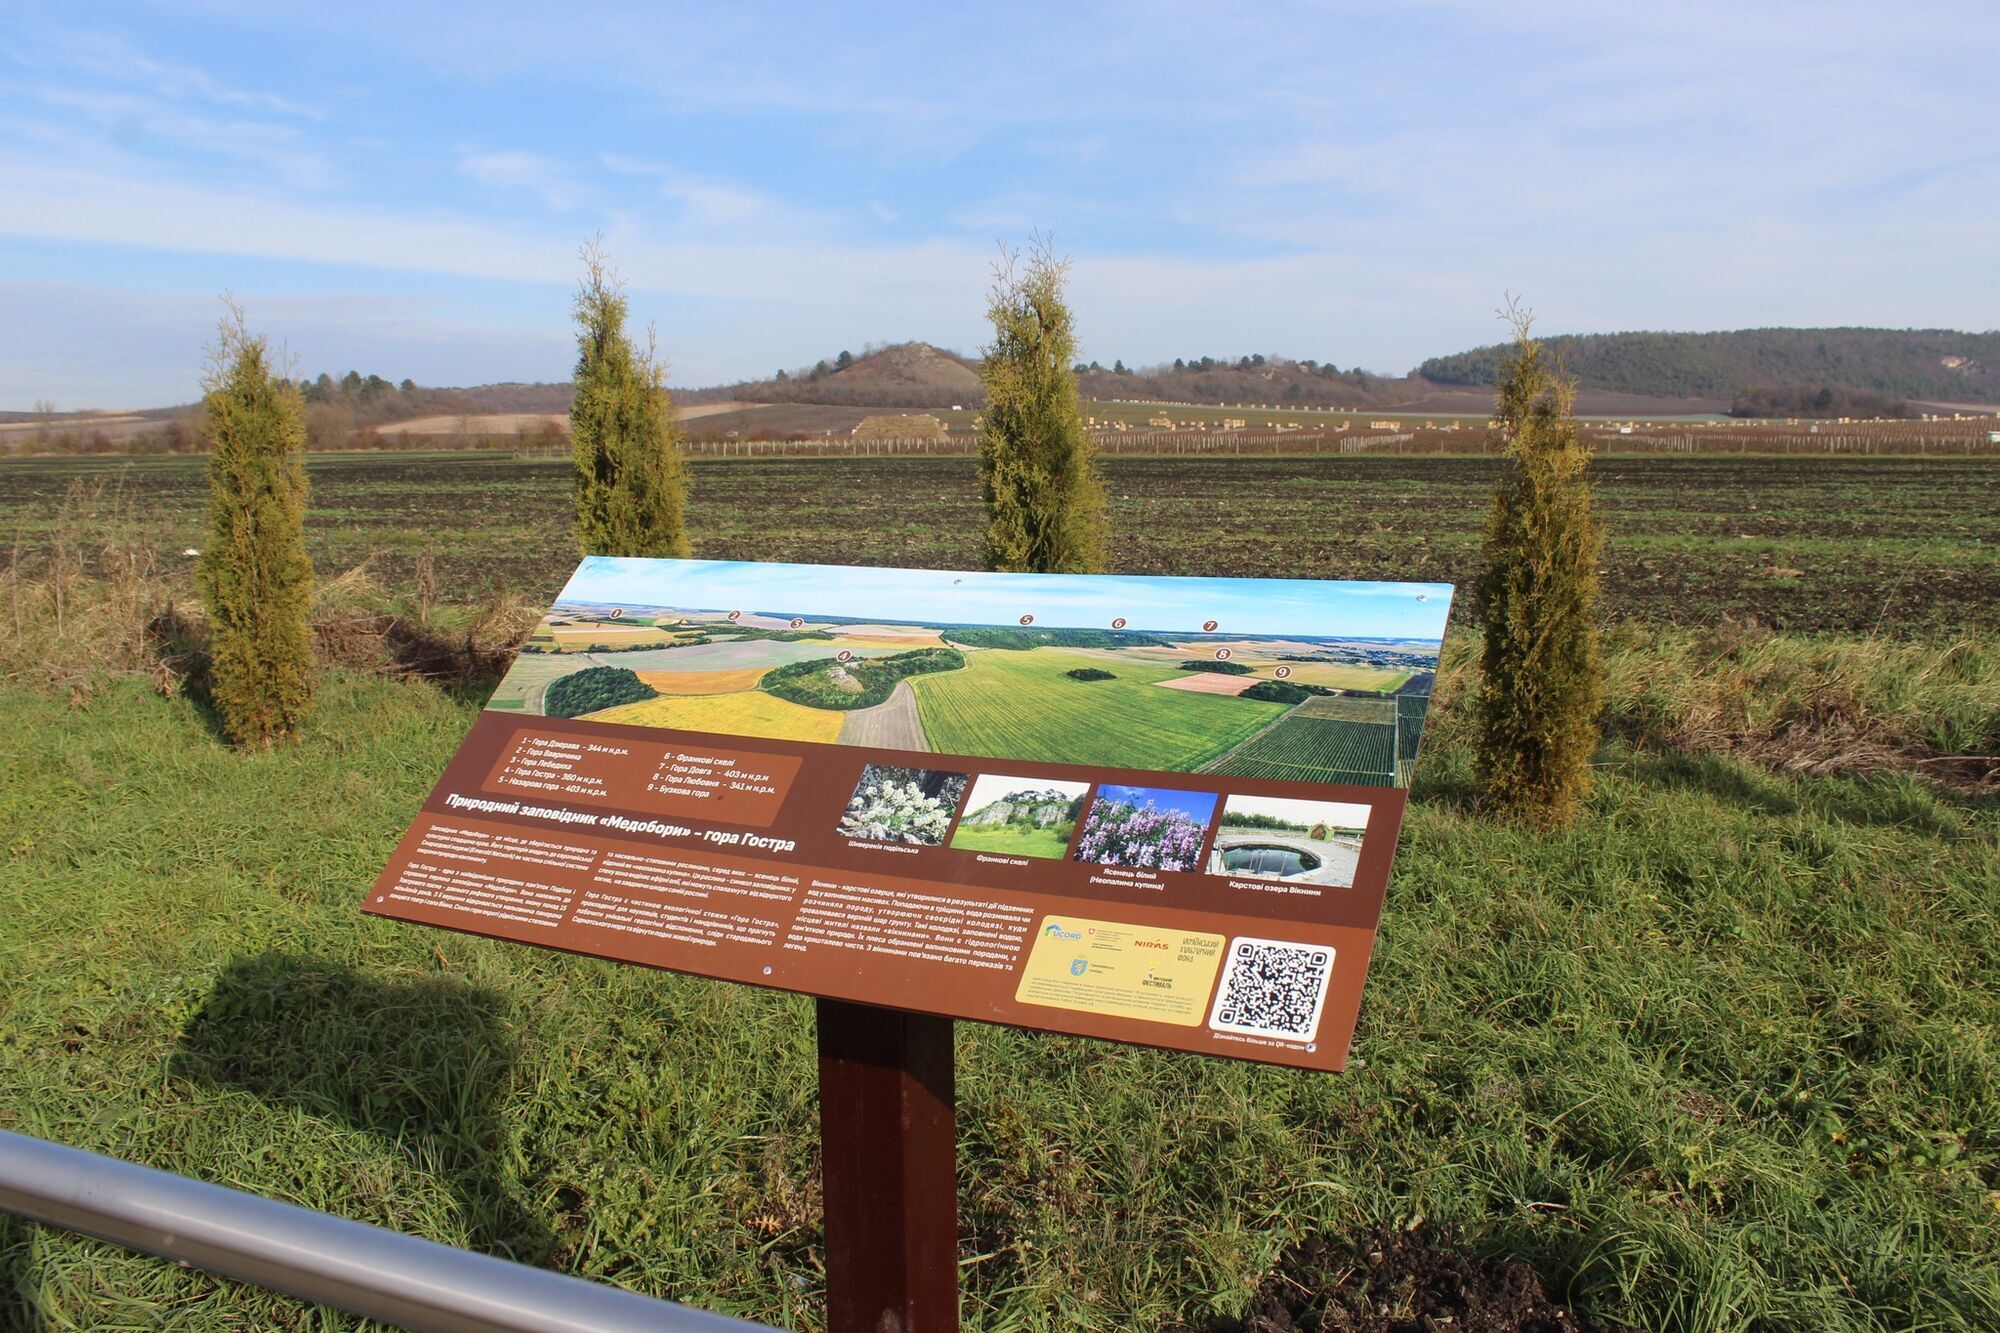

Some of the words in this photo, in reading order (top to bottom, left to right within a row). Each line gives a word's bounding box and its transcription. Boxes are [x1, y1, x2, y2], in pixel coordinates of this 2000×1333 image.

[531, 738, 548, 746] Гора
[546, 740, 580, 749] Дзюрава
[526, 748, 543, 756] Гора
[542, 749, 581, 760] Вавричина
[676, 753, 714, 764] Франкові
[713, 758, 735, 766] скелі
[520, 757, 537, 766] Гора
[536, 759, 572, 769] Лебедиха
[514, 767, 531, 776] Гора
[531, 769, 555, 779] Гостра
[560, 773, 576, 781] 360
[669, 764, 688, 773] Гора
[687, 766, 712, 775] Довга
[723, 770, 740, 778] 403
[508, 777, 542, 787] Назарова
[564, 784, 580, 792] 403
[664, 774, 683, 783] Гора
[682, 776, 719, 787] Любовня
[729, 781, 745, 790] 341
[658, 785, 691, 795] Бузкова
[690, 790, 709, 798] гора
[445, 793, 520, 813] Природний
[518, 805, 598, 824] заповідник
[599, 815, 691, 836] «Медобори»
[703, 830, 739, 844] гора
[740, 832, 795, 851] Гостра
[976, 854, 1009, 863] Франкові
[1228, 880, 1263, 890] Карстові
[1264, 885, 1288, 893] озера
[802, 898, 843, 908] розчиняла
[845, 904, 874, 913] породу,
[877, 908, 922, 918] утворюючи
[924, 914, 964, 924] своєрідні
[965, 919, 1003, 930] колодязі,
[1053, 930, 1082, 940] UCORD
